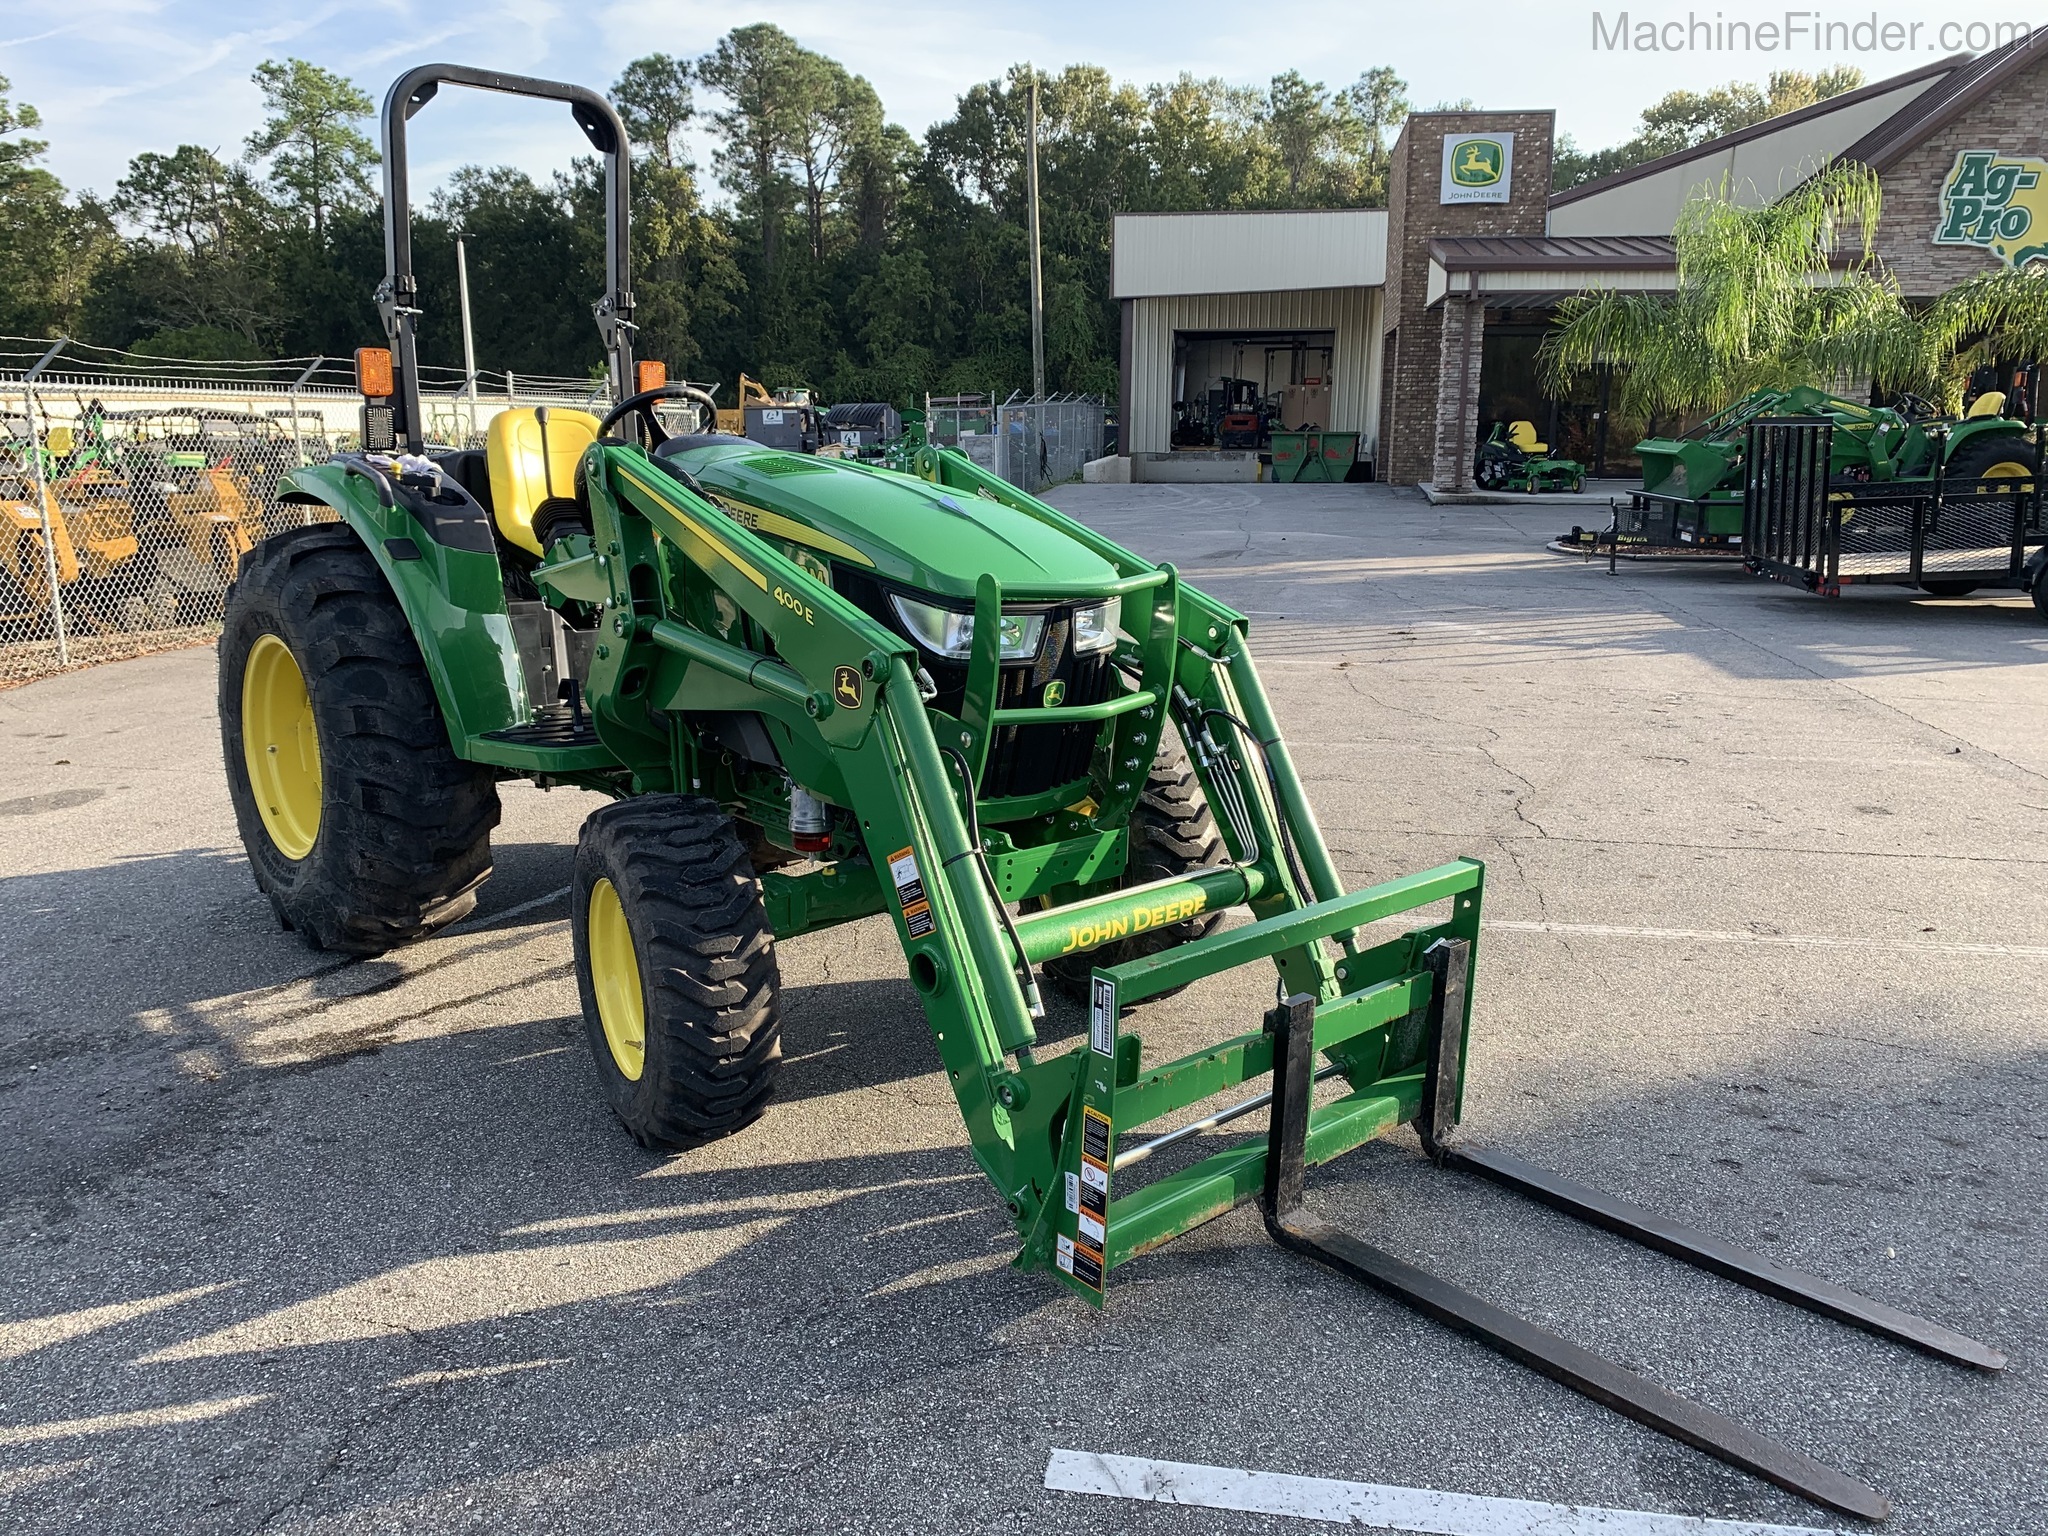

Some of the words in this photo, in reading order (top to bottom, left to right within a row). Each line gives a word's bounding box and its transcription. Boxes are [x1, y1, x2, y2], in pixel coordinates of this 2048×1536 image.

[1473, 191, 1503, 199] DEERE
[1946, 153, 2040, 207] Ag-
[1939, 197, 2032, 240] Pro
[773, 586, 803, 616] 400
[1062, 916, 1128, 952] JOHN
[1133, 896, 1207, 932] DEERE
